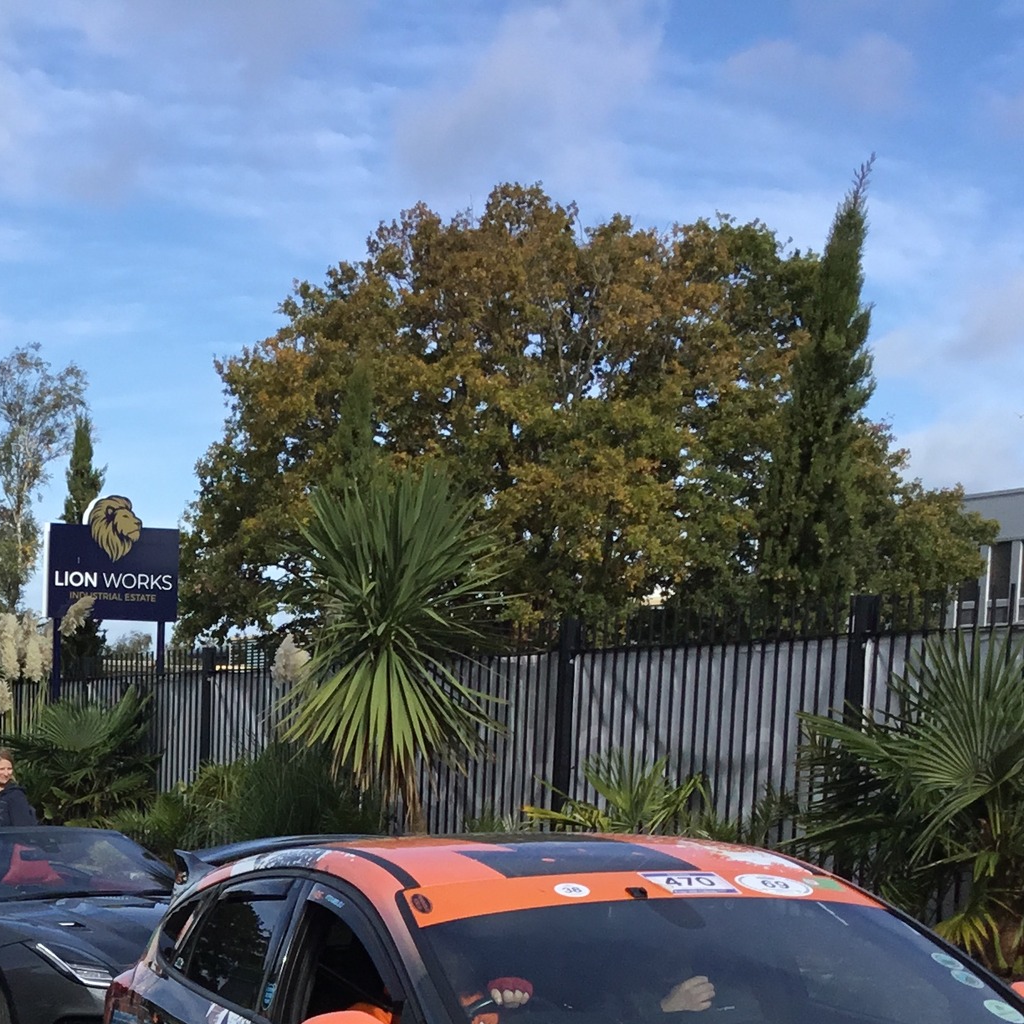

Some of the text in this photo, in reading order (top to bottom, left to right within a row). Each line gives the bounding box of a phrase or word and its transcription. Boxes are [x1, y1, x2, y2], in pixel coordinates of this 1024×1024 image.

[55, 570, 173, 591] LION WORKS
[125, 592, 156, 602] ESTATE
[665, 876, 716, 887] 470
[760, 879, 790, 889] 69
